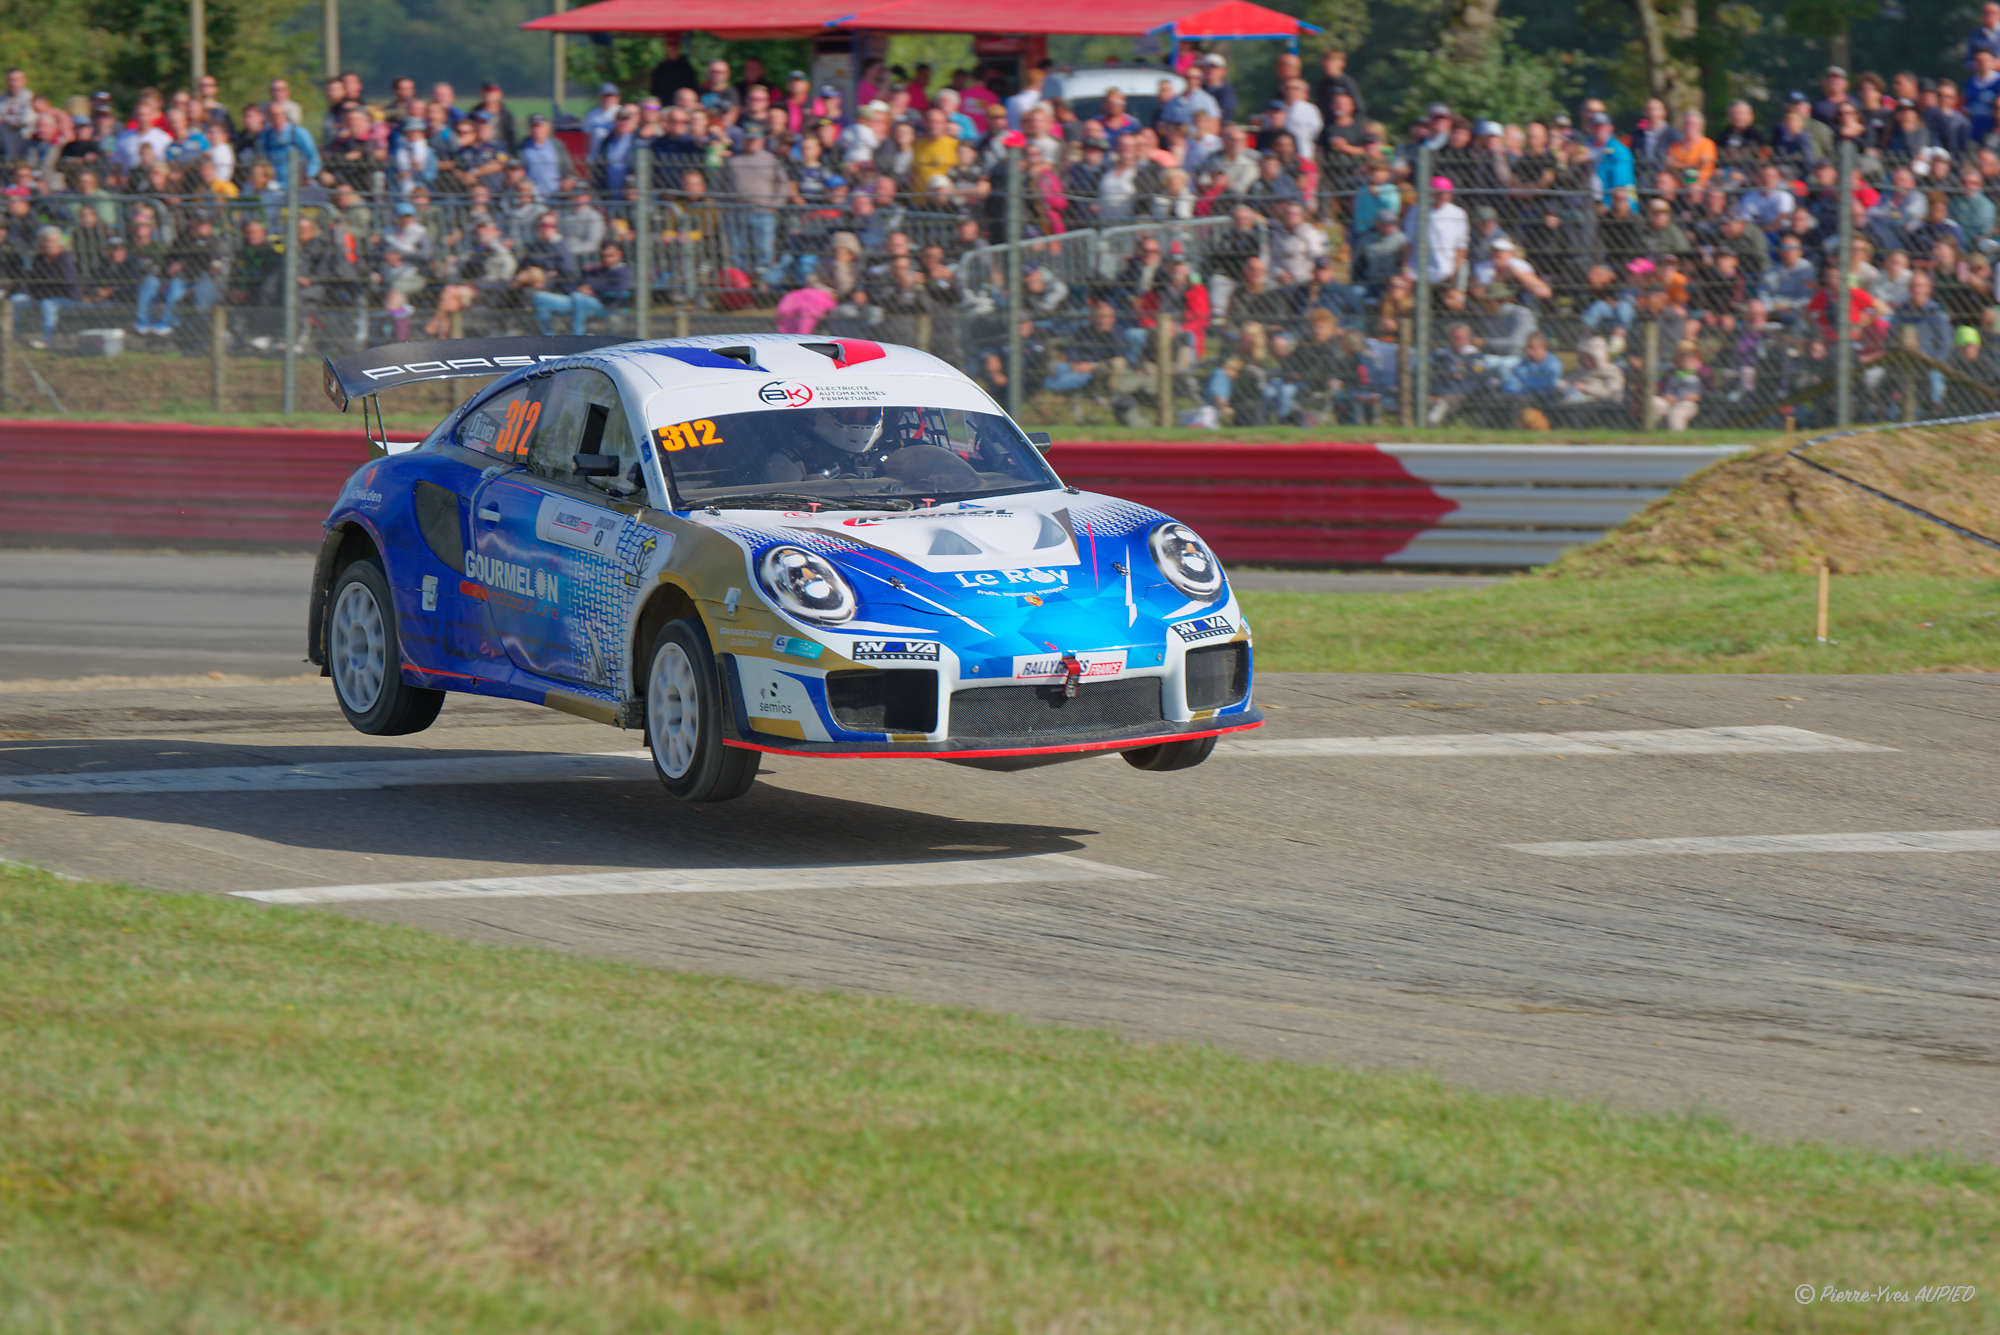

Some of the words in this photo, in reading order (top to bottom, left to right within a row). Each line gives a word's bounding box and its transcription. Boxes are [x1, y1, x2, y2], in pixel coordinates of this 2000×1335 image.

[495, 400, 542, 455] 312
[657, 419, 725, 452] 312
[465, 550, 559, 603] GOURMELON
[954, 573, 1000, 588] Le
[759, 701, 792, 714] semios
